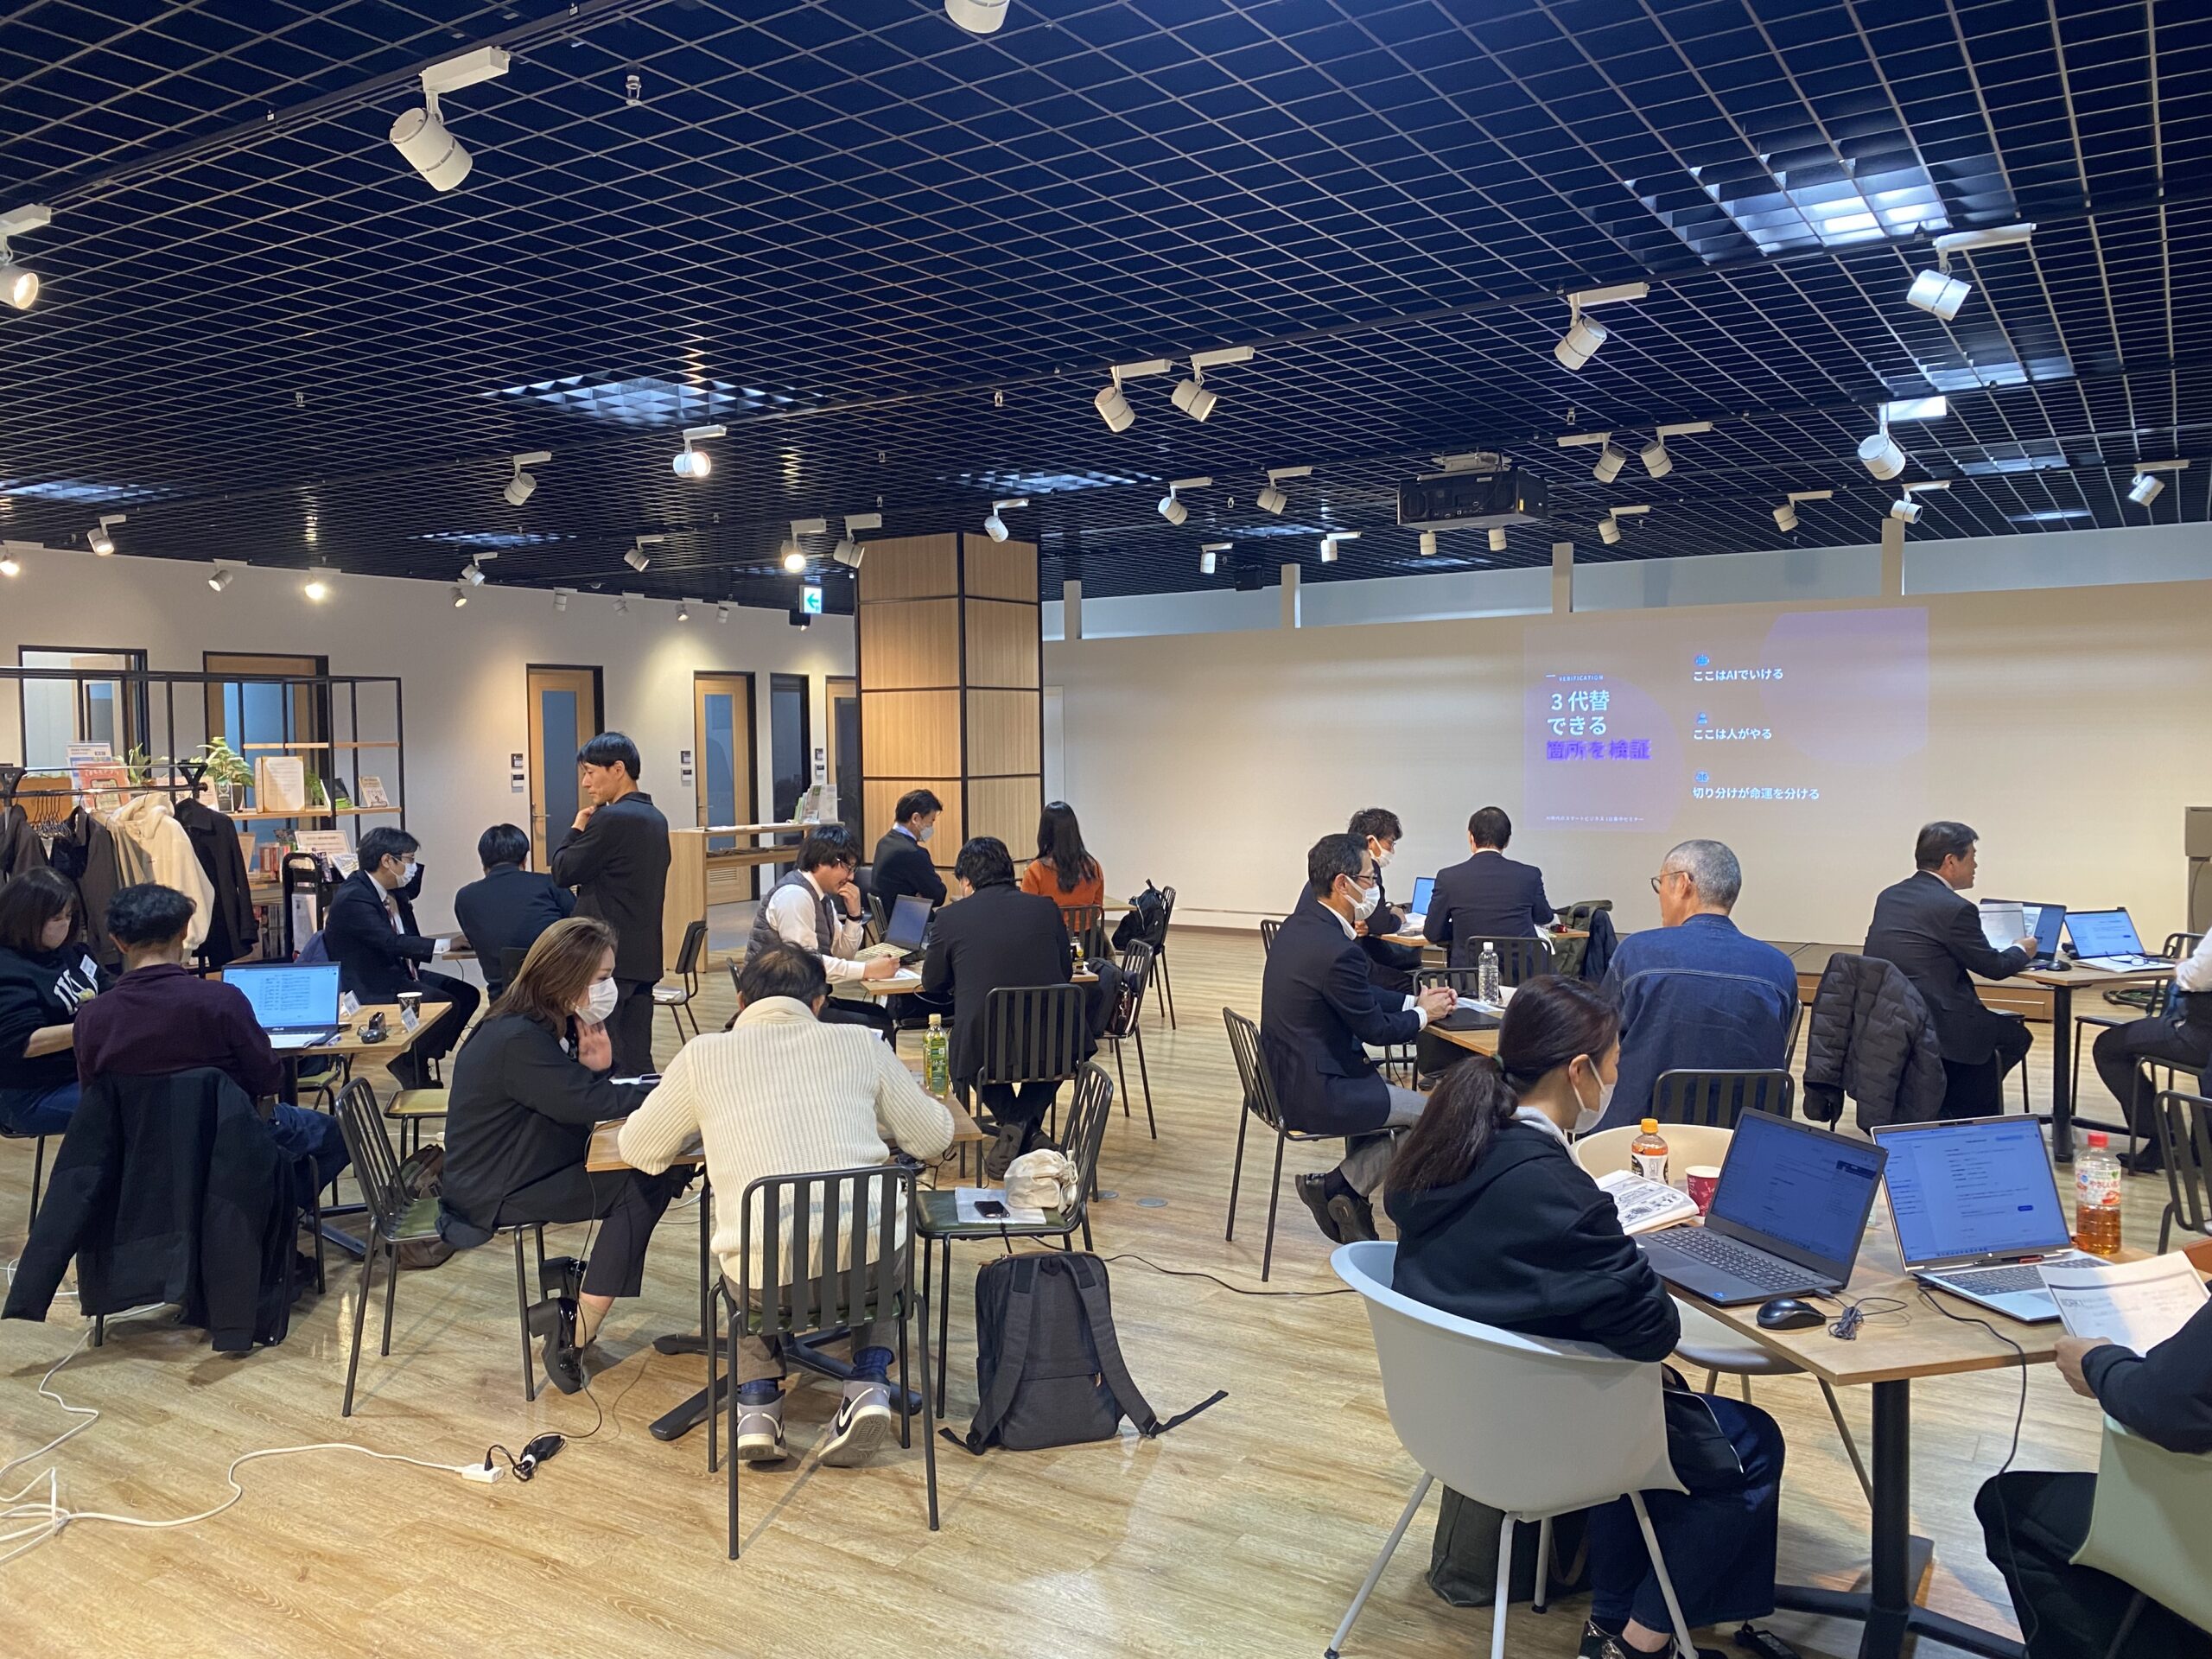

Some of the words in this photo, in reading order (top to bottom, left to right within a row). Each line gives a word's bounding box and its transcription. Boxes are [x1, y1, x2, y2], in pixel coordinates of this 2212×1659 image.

[1693, 668, 1783, 682] ここはAIでいける
[1547, 715, 1607, 736] できる
[1693, 728, 1772, 741] ここは人がやる
[1547, 739, 1652, 761] 箇所を検証
[1693, 787, 1820, 800] 切り分けが命運を分ける
